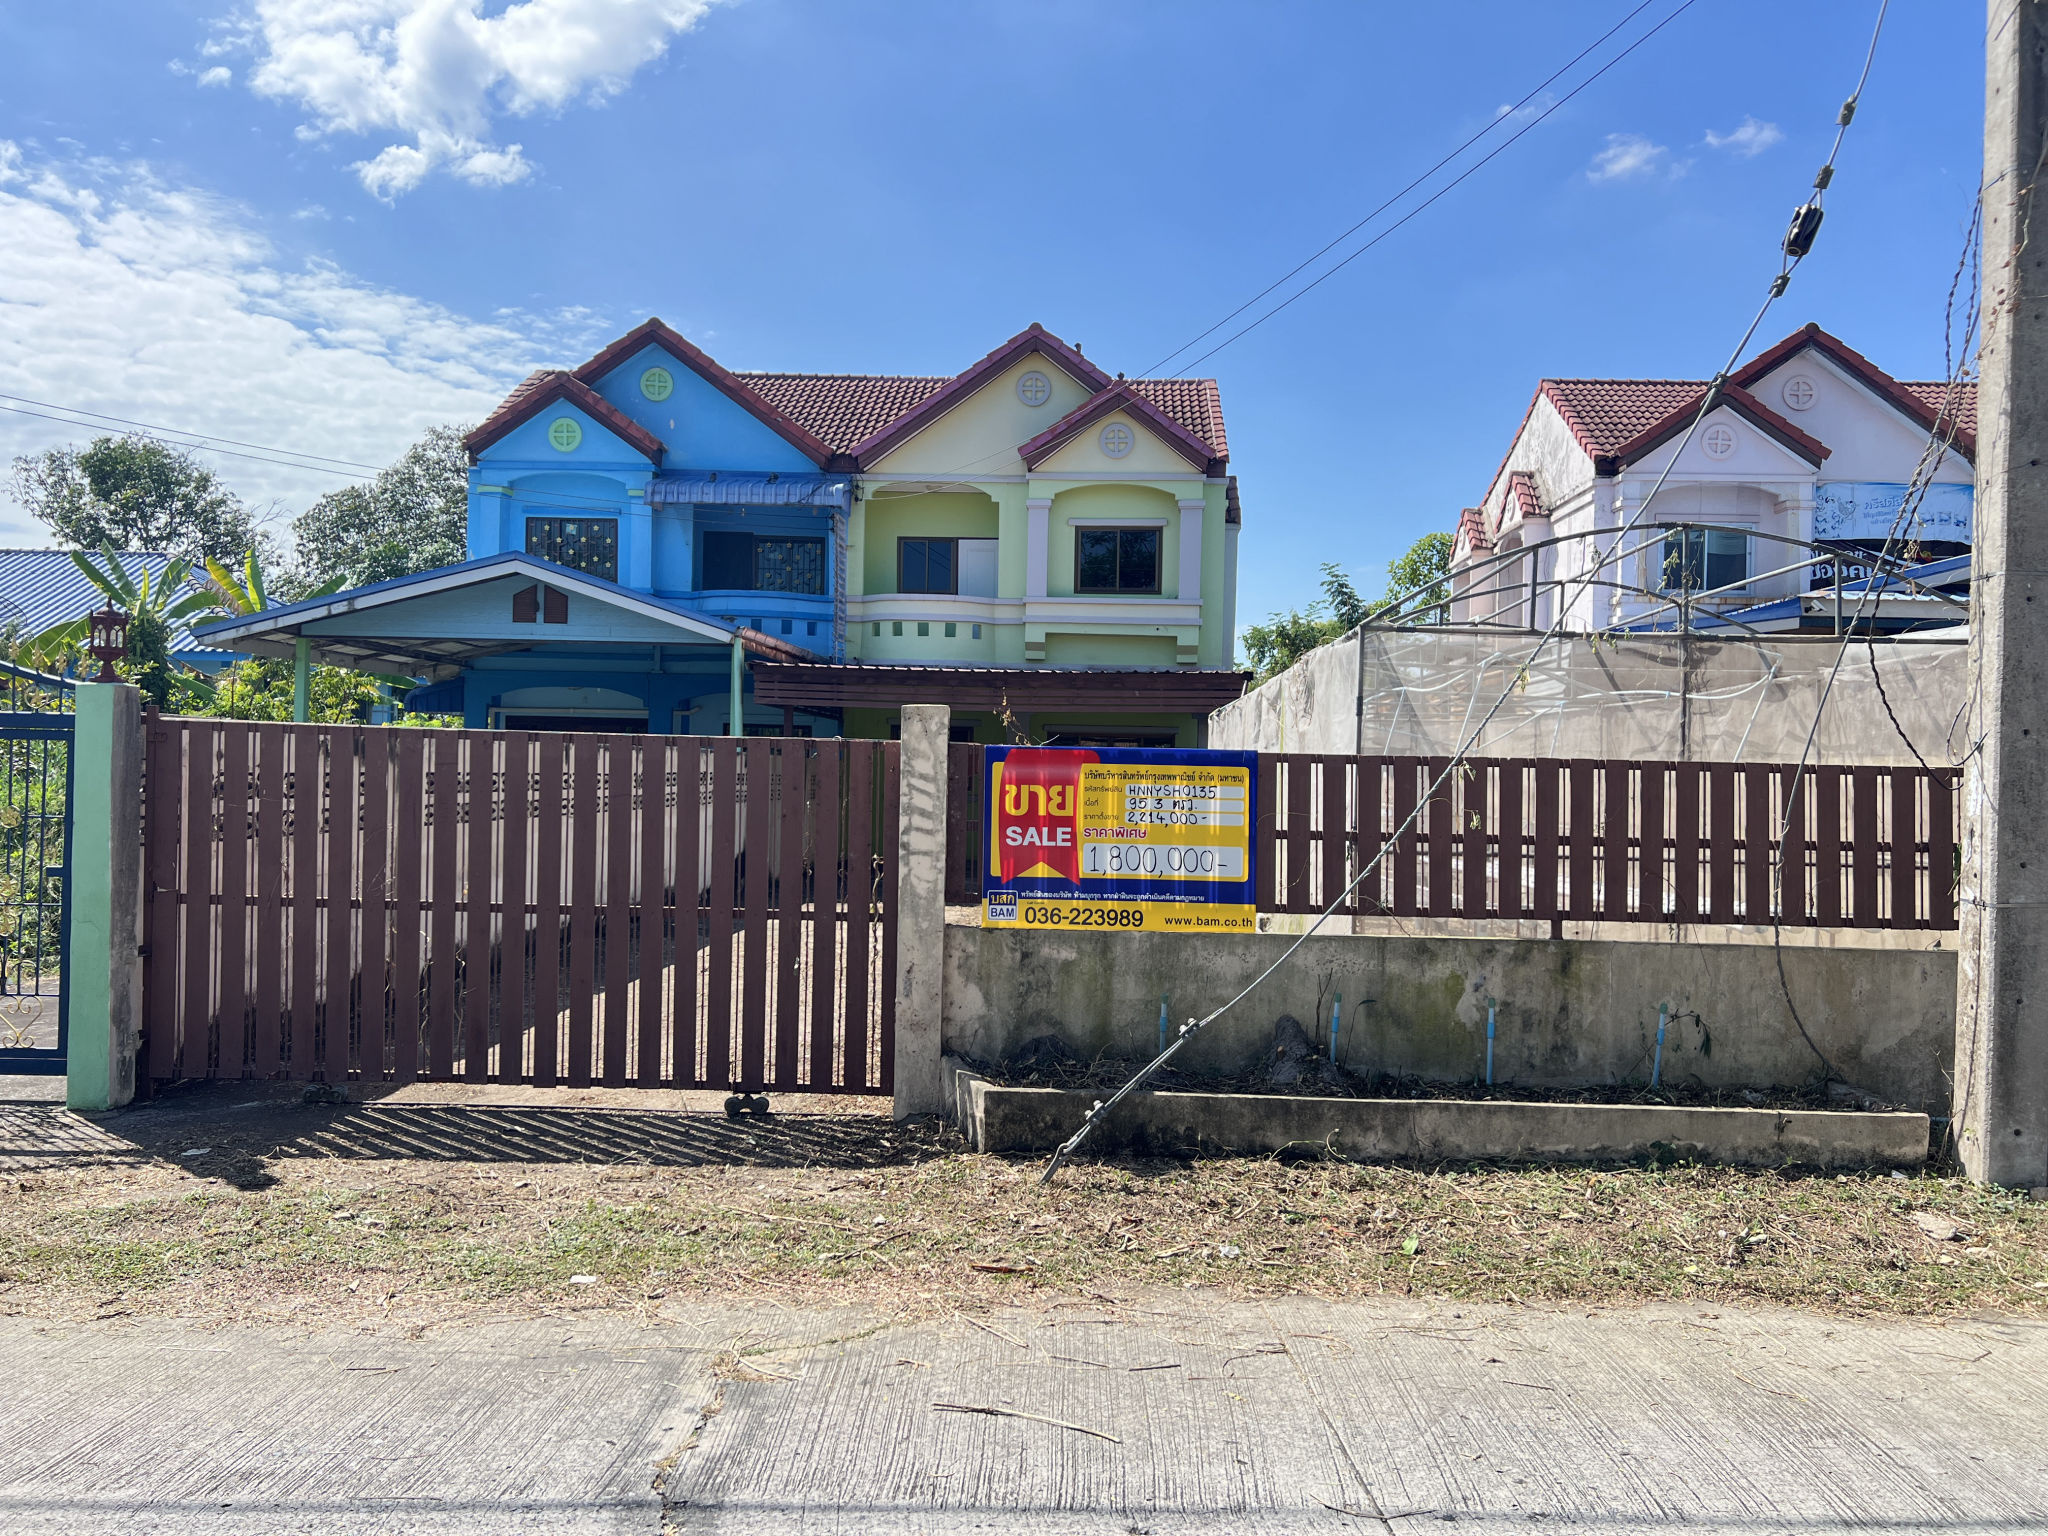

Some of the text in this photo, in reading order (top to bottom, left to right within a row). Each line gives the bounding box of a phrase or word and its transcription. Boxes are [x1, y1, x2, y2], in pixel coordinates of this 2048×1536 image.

[1198, 771, 1215, 781] จำกัด
[1217, 773, 1244, 783] (มหาชน)
[1005, 784, 1074, 816] ขาย
[1005, 826, 1072, 846] SALE
[1083, 827, 1147, 839] ราคาพิเศษ
[990, 893, 1014, 905] บสก
[990, 906, 1015, 918] BAM
[1024, 907, 1144, 927] 036-223989
[1164, 916, 1253, 927] www.bam.co.th
